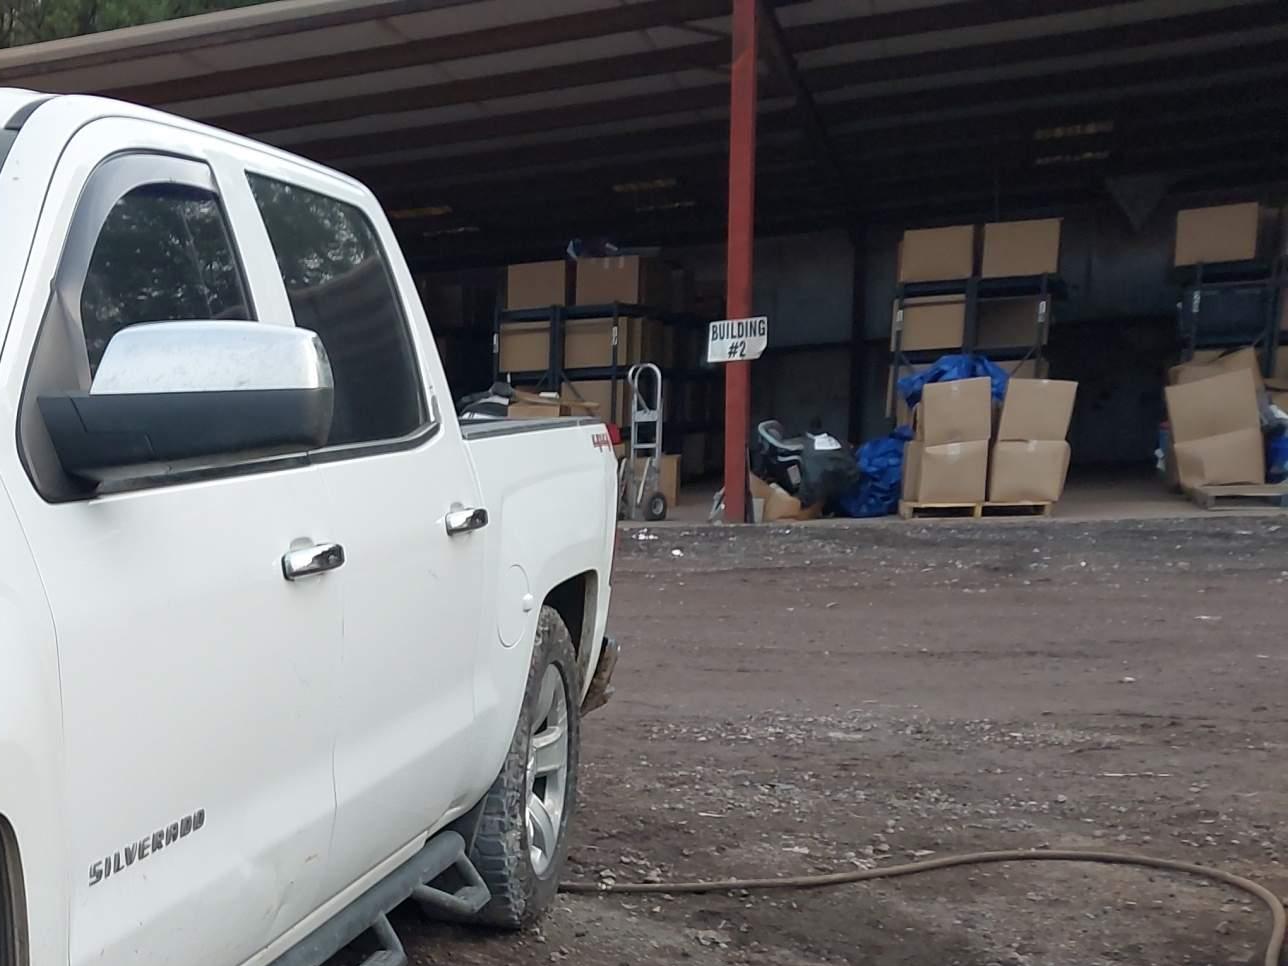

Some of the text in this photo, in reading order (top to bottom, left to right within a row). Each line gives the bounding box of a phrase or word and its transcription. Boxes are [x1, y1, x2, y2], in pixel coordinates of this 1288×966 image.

[711, 319, 766, 341] BUILDING
[727, 340, 747, 359] #2
[88, 808, 206, 887] SILVERADO
